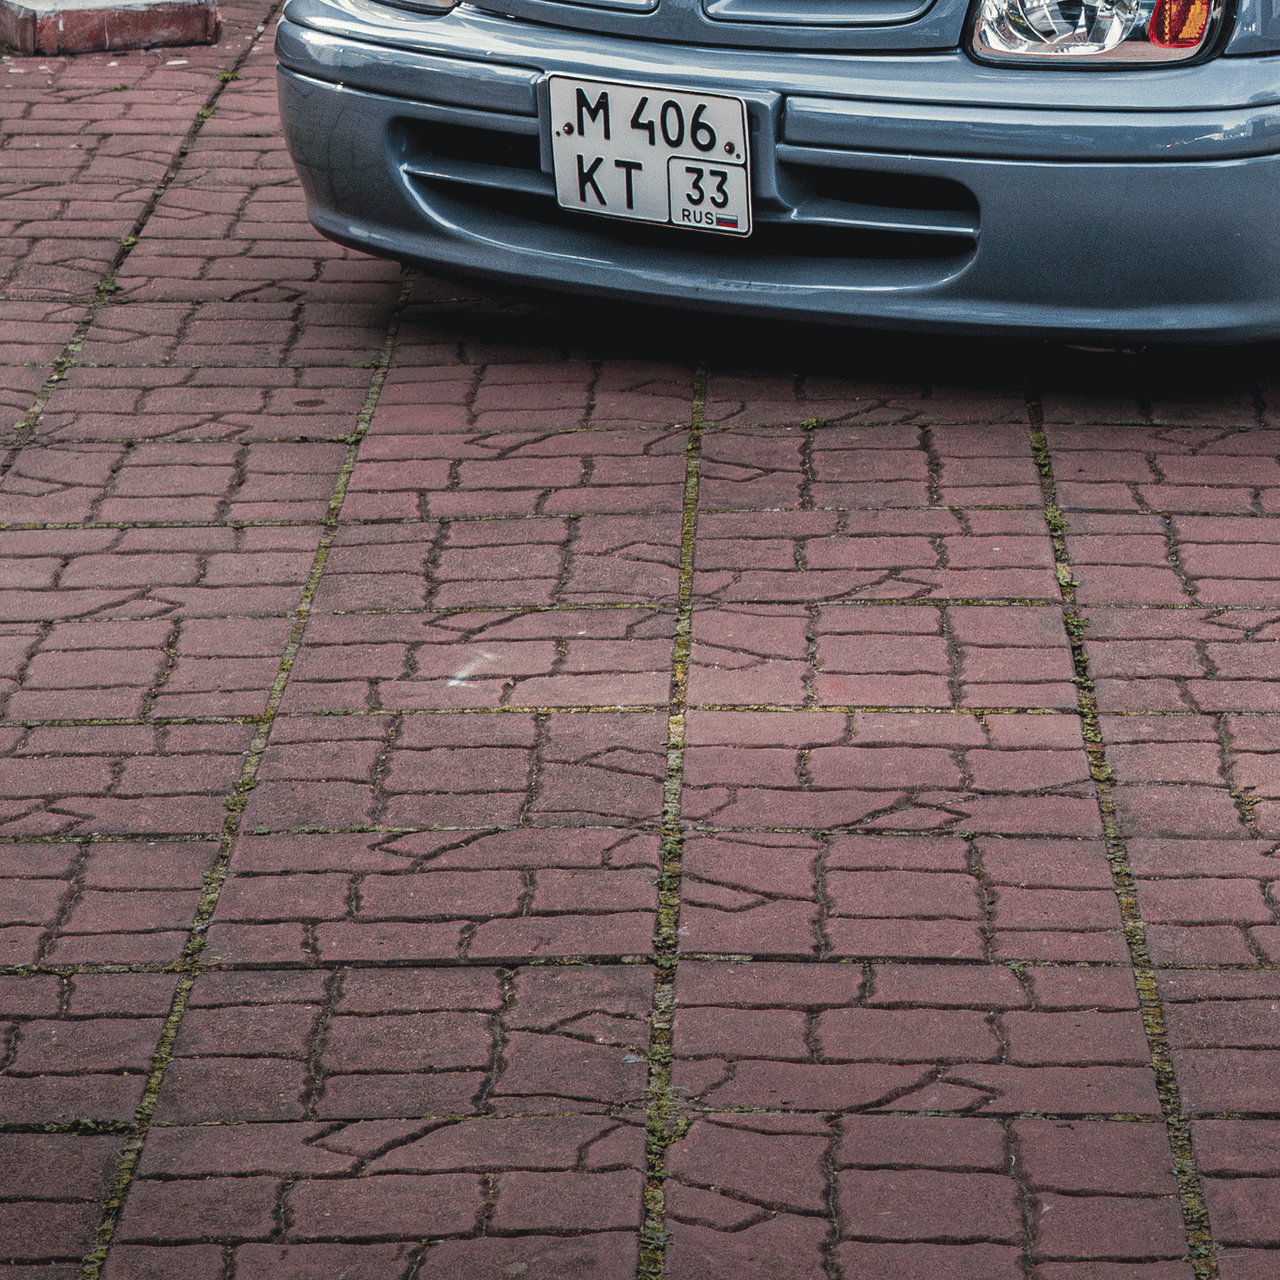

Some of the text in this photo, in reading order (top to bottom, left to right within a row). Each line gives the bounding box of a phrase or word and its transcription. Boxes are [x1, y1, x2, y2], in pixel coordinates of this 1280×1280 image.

[630, 96, 717, 153] 406
[685, 166, 729, 209] 33
[681, 208, 715, 226] RUS
